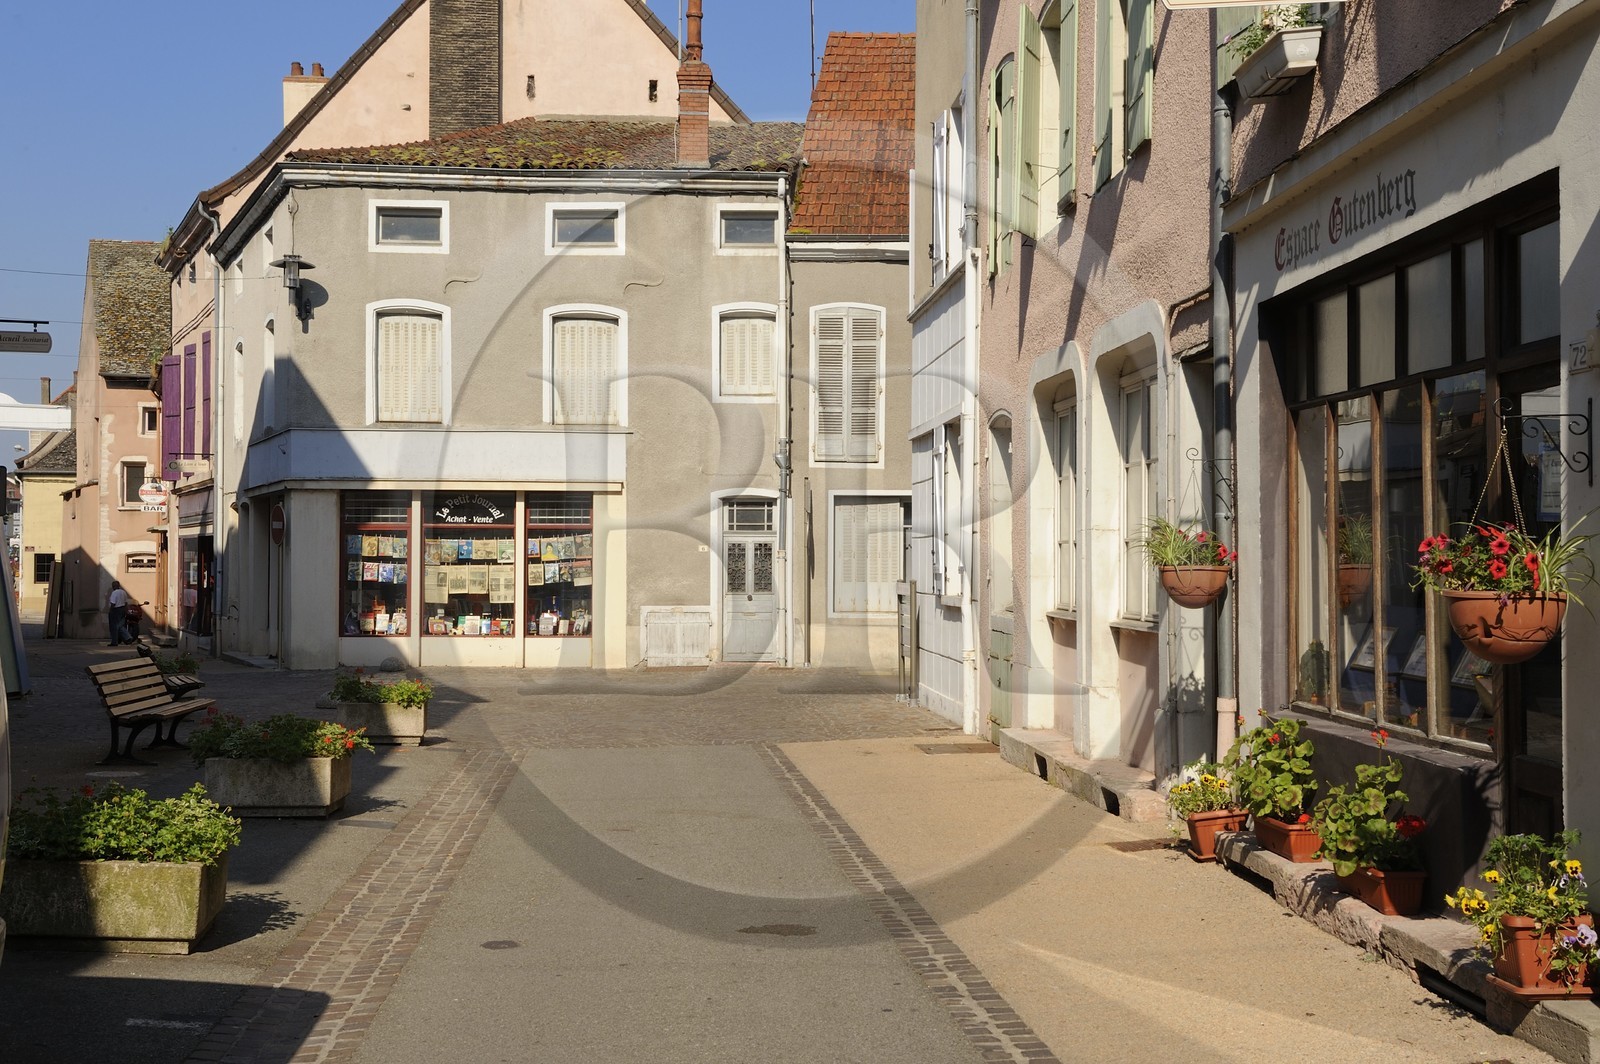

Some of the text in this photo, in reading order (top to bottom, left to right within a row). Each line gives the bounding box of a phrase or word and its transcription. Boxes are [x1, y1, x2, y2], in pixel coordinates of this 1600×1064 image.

[1274, 168, 1417, 272] Espace Gutenberg
[1572, 345, 1587, 366] 72
[435, 494, 505, 520] Le Petit Journal
[445, 515, 467, 523] Achat
[472, 515, 494, 523] Vente
